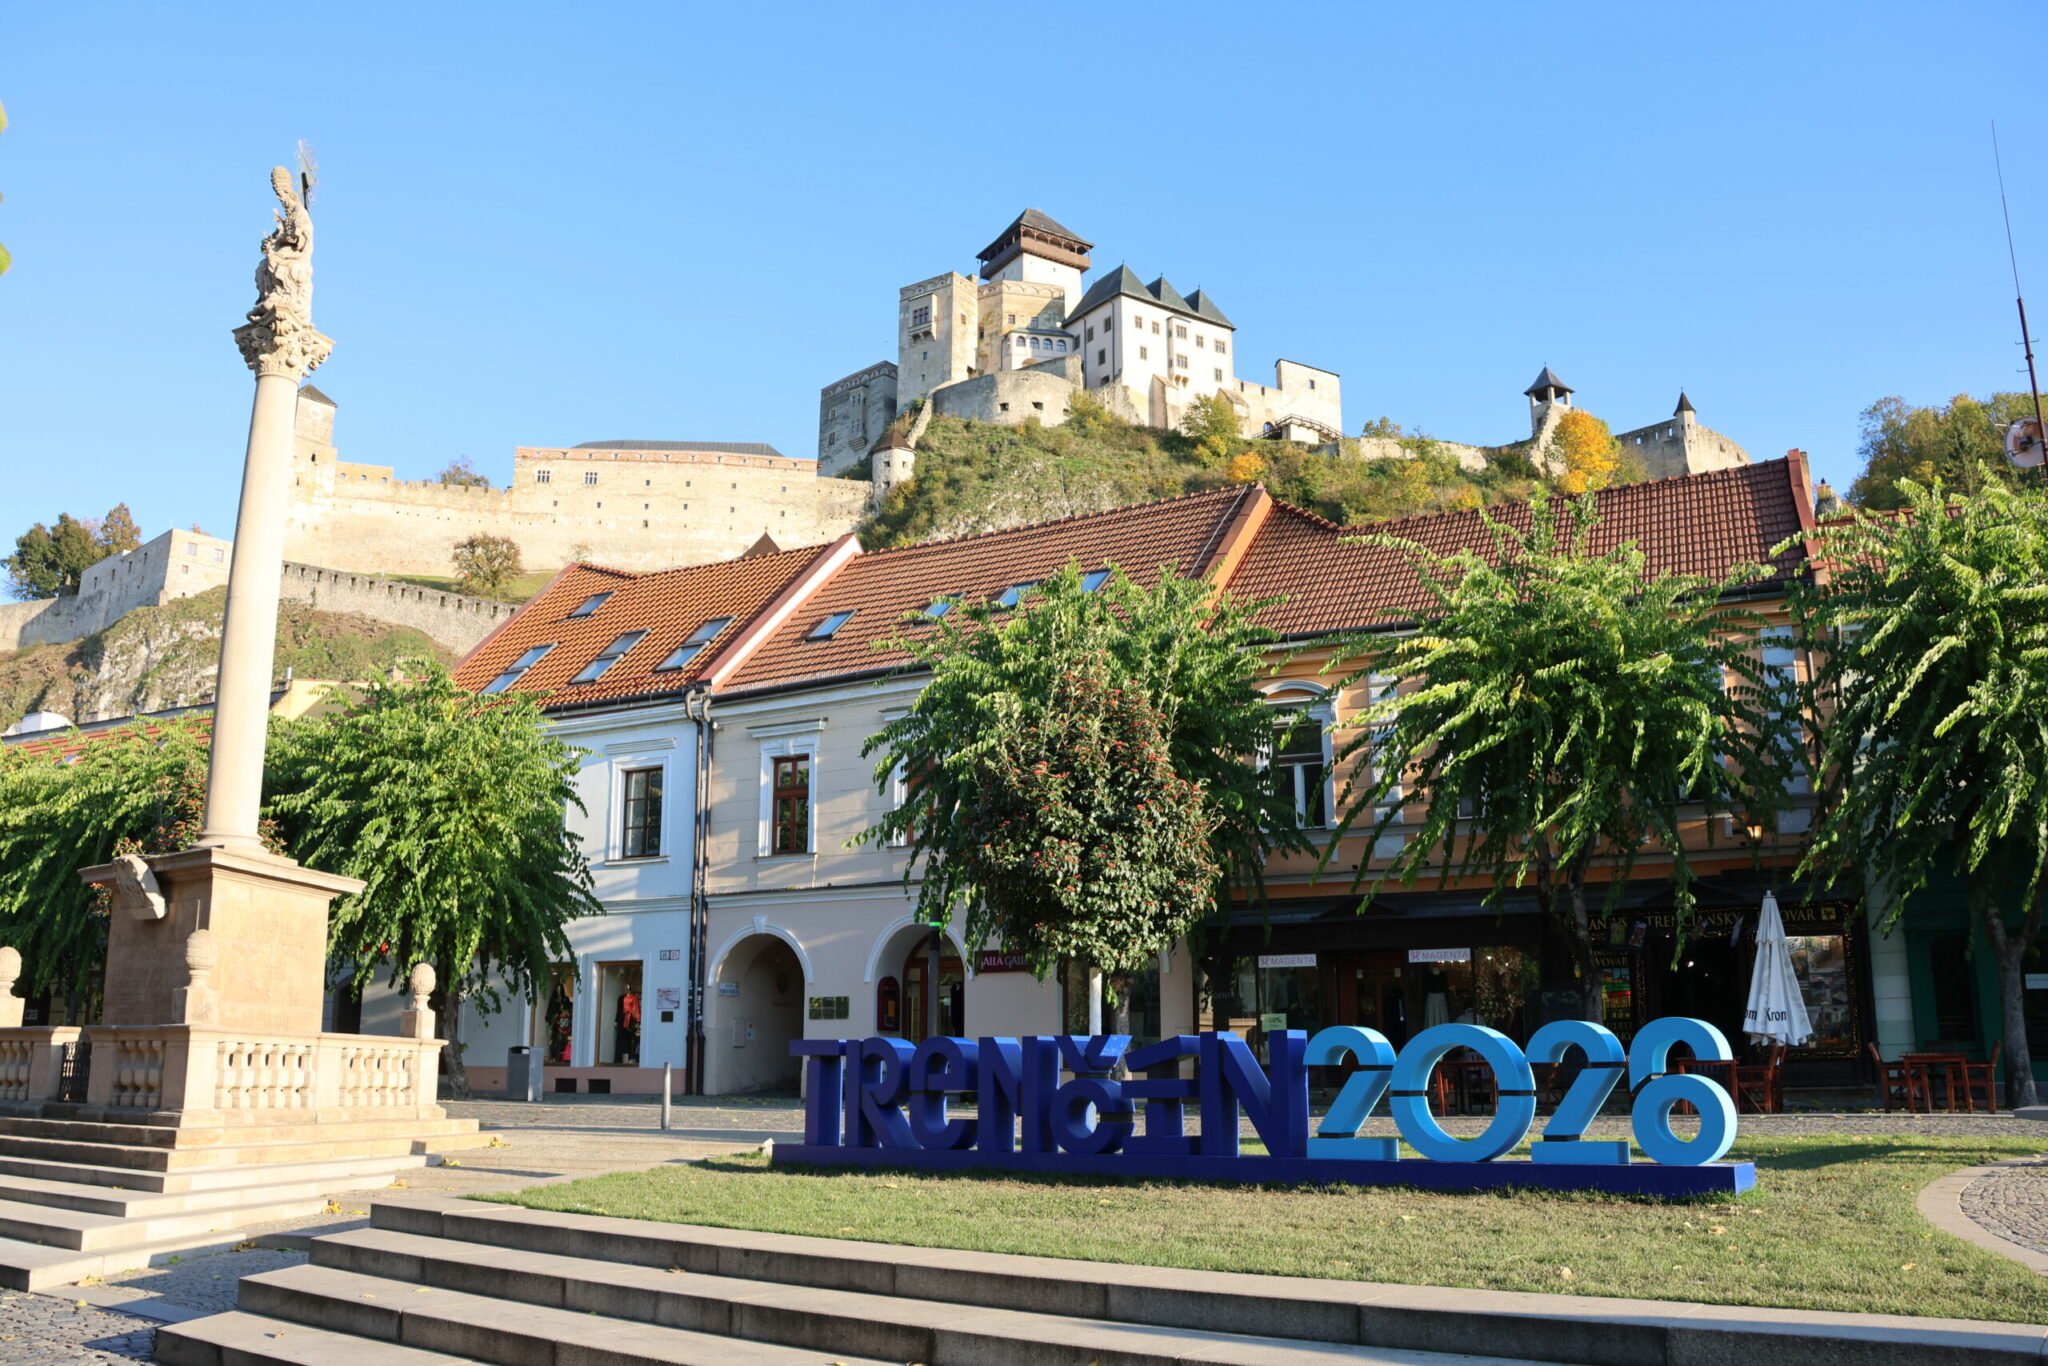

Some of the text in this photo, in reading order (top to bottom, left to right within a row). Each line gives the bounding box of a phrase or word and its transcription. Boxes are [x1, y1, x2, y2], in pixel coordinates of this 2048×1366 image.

[1271, 956, 1316, 966] MAGENTA
[1422, 950, 1469, 961] MAGENTA
[1303, 1017, 1737, 1165] 2026
